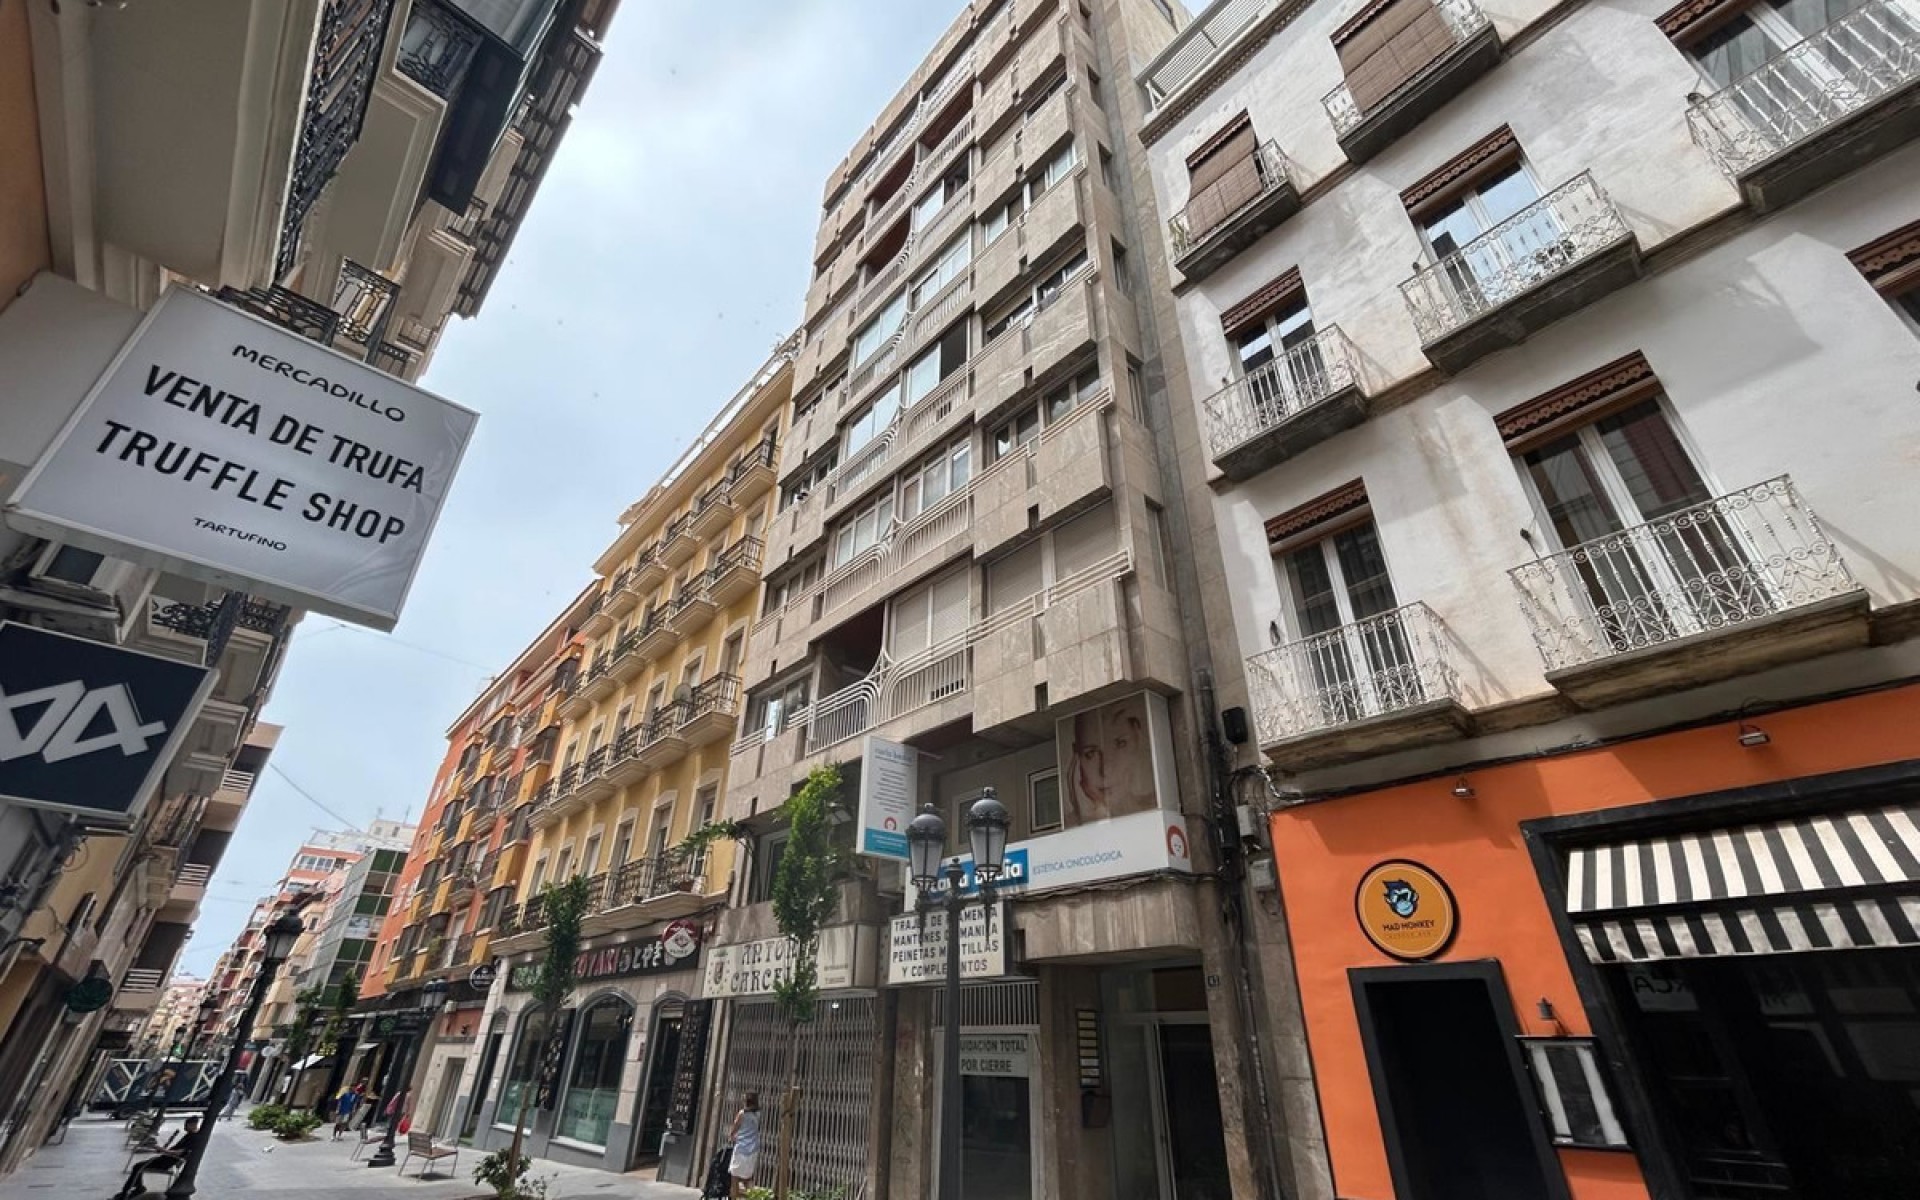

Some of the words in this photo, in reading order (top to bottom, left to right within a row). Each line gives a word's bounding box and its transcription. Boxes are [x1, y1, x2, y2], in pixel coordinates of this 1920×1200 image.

[232, 344, 406, 423] MERCADILLO
[143, 365, 261, 435] VENTA
[269, 414, 325, 455] DE
[328, 434, 425, 494] TRUFA
[95, 420, 296, 511] TRUFFLE
[302, 492, 406, 544] SHOP
[194, 517, 288, 551] TARTUFINO
[931, 914, 943, 927] DE
[1382, 922, 1400, 931] MAD
[1401, 920, 1434, 930] MONKEY
[960, 922, 998, 938] MANIA
[893, 946, 935, 963] PEINETAS
[939, 940, 999, 957] MTILLAS
[902, 966, 908, 977] Y
[911, 959, 988, 977] COMPLENTOS
[1000, 1039, 1027, 1052] TOTAL
[961, 1058, 978, 1071] POR
[980, 1059, 1012, 1073] CIERRE
